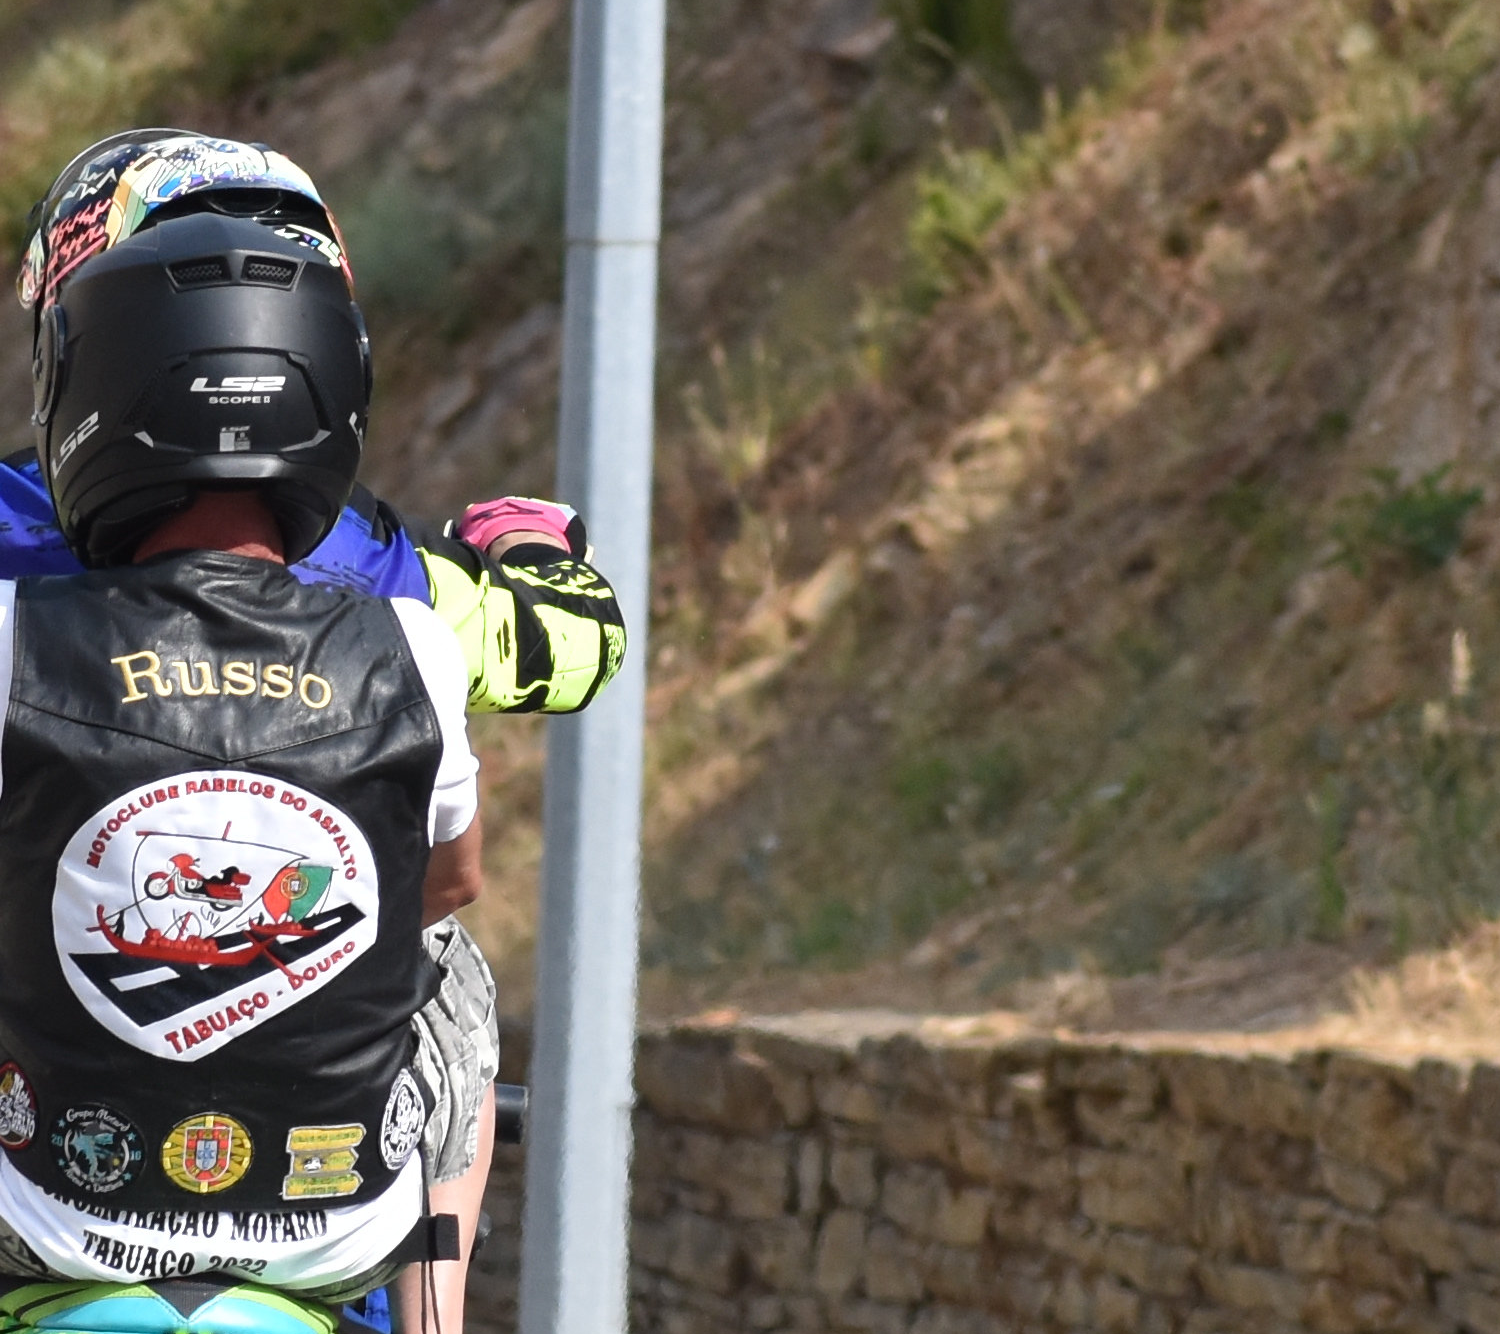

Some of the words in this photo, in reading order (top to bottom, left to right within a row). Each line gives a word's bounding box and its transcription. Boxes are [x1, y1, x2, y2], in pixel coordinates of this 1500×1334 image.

[190, 376, 286, 392] LS2
[208, 396, 261, 404] SCOPE
[51, 411, 99, 479] LS2
[110, 650, 332, 709] Russo
[86, 784, 180, 869] MOTOCLUBE
[185, 777, 275, 799] RABELOS
[280, 789, 307, 812] DO
[309, 808, 357, 880] ASFALTO
[164, 991, 270, 1054] TABUAÇO
[287, 940, 356, 991] DOURO
[82, 1229, 195, 1278] TABUAÇO
[230, 1210, 328, 1243] MOTARD
